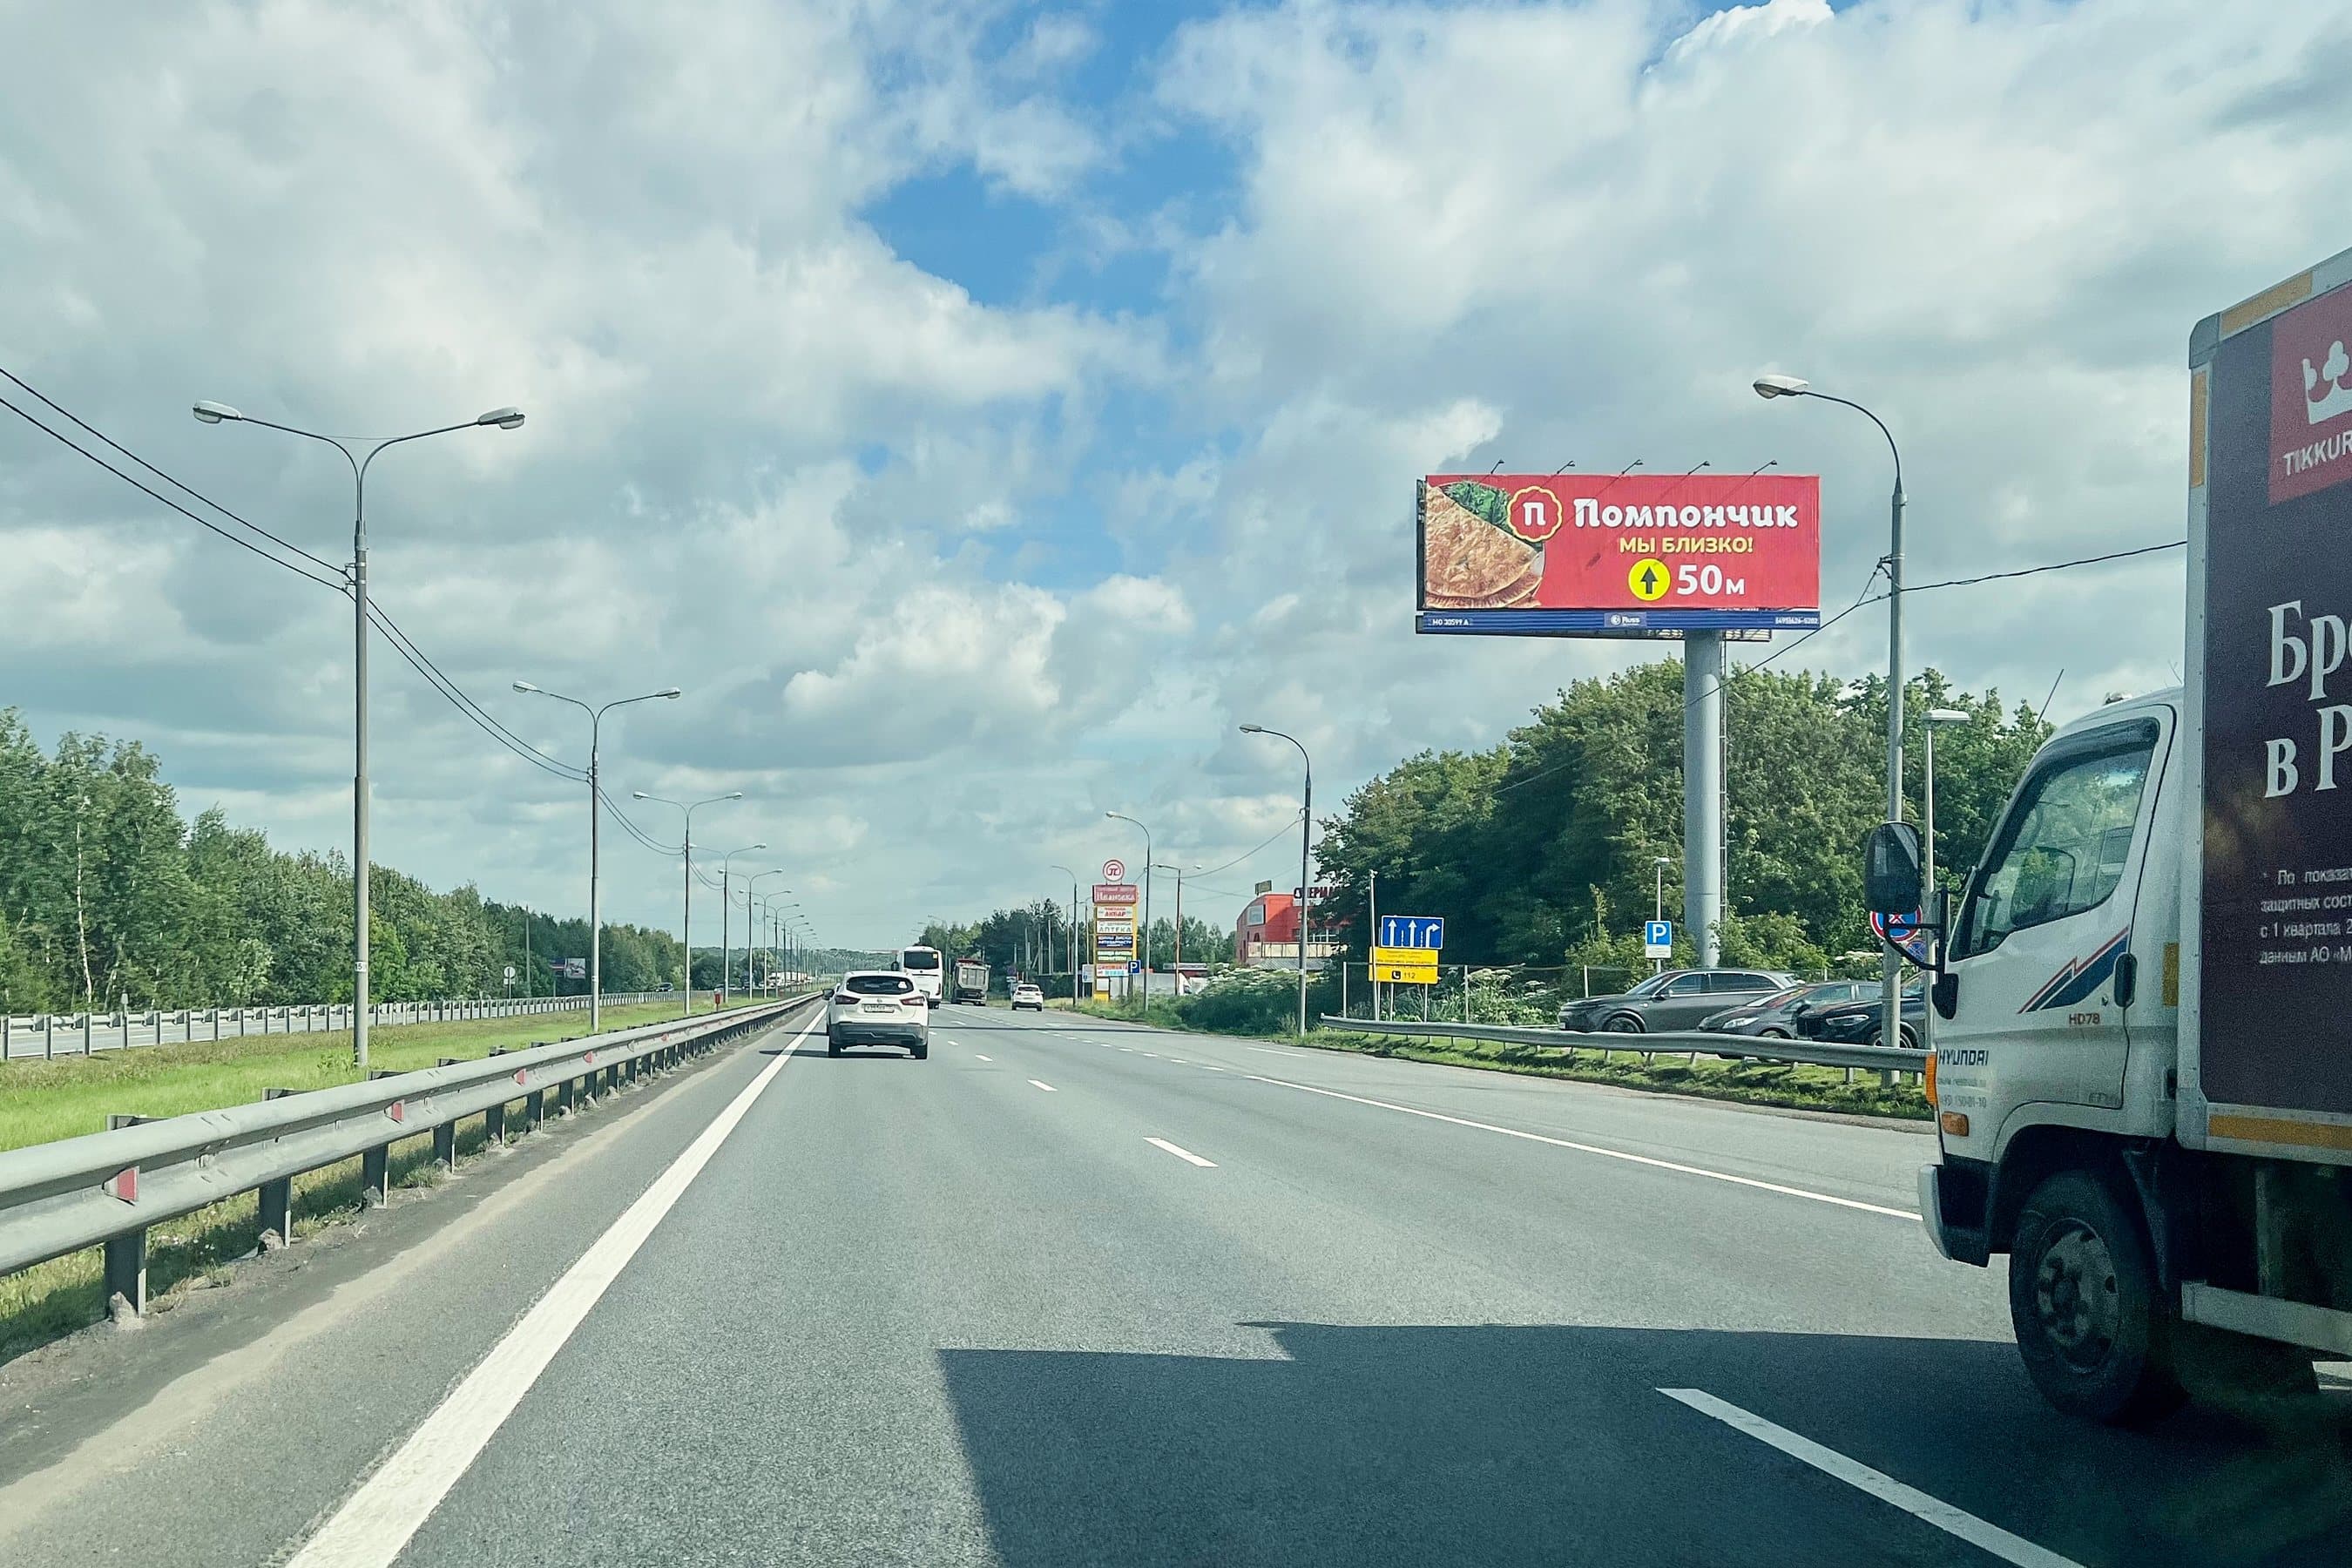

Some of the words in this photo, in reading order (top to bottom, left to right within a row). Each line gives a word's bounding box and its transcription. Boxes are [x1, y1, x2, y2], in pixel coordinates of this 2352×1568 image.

[2283, 430, 2352, 476] TIKKUR
[1573, 498, 1798, 529] Помпончик
[1619, 537, 1656, 553] МЫ
[1662, 537, 1754, 553] БЛИЗКО!
[2265, 599, 2352, 701] Бр
[2265, 738, 2300, 798] в
[1652, 923, 1667, 943] P
[2068, 1013, 2100, 1024] HD78
[1938, 1049, 1989, 1066] HYUNDAI
